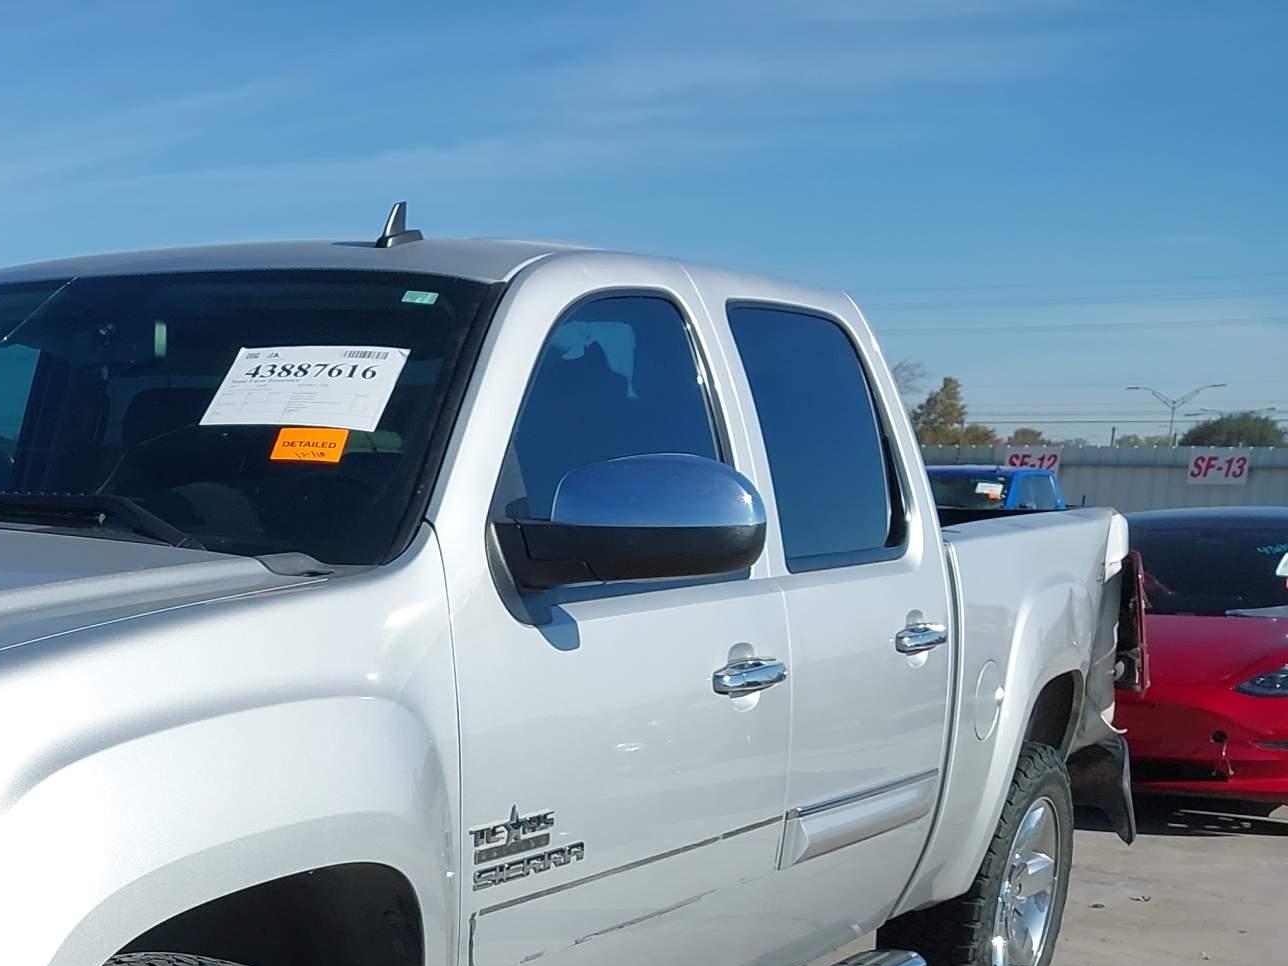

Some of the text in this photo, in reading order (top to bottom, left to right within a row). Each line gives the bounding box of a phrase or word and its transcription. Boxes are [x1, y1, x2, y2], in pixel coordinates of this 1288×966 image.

[244, 363, 379, 380] 43887616
[282, 440, 337, 449] DETAILED
[1190, 455, 1248, 478] SF-13
[472, 841, 585, 892] SIERRA
